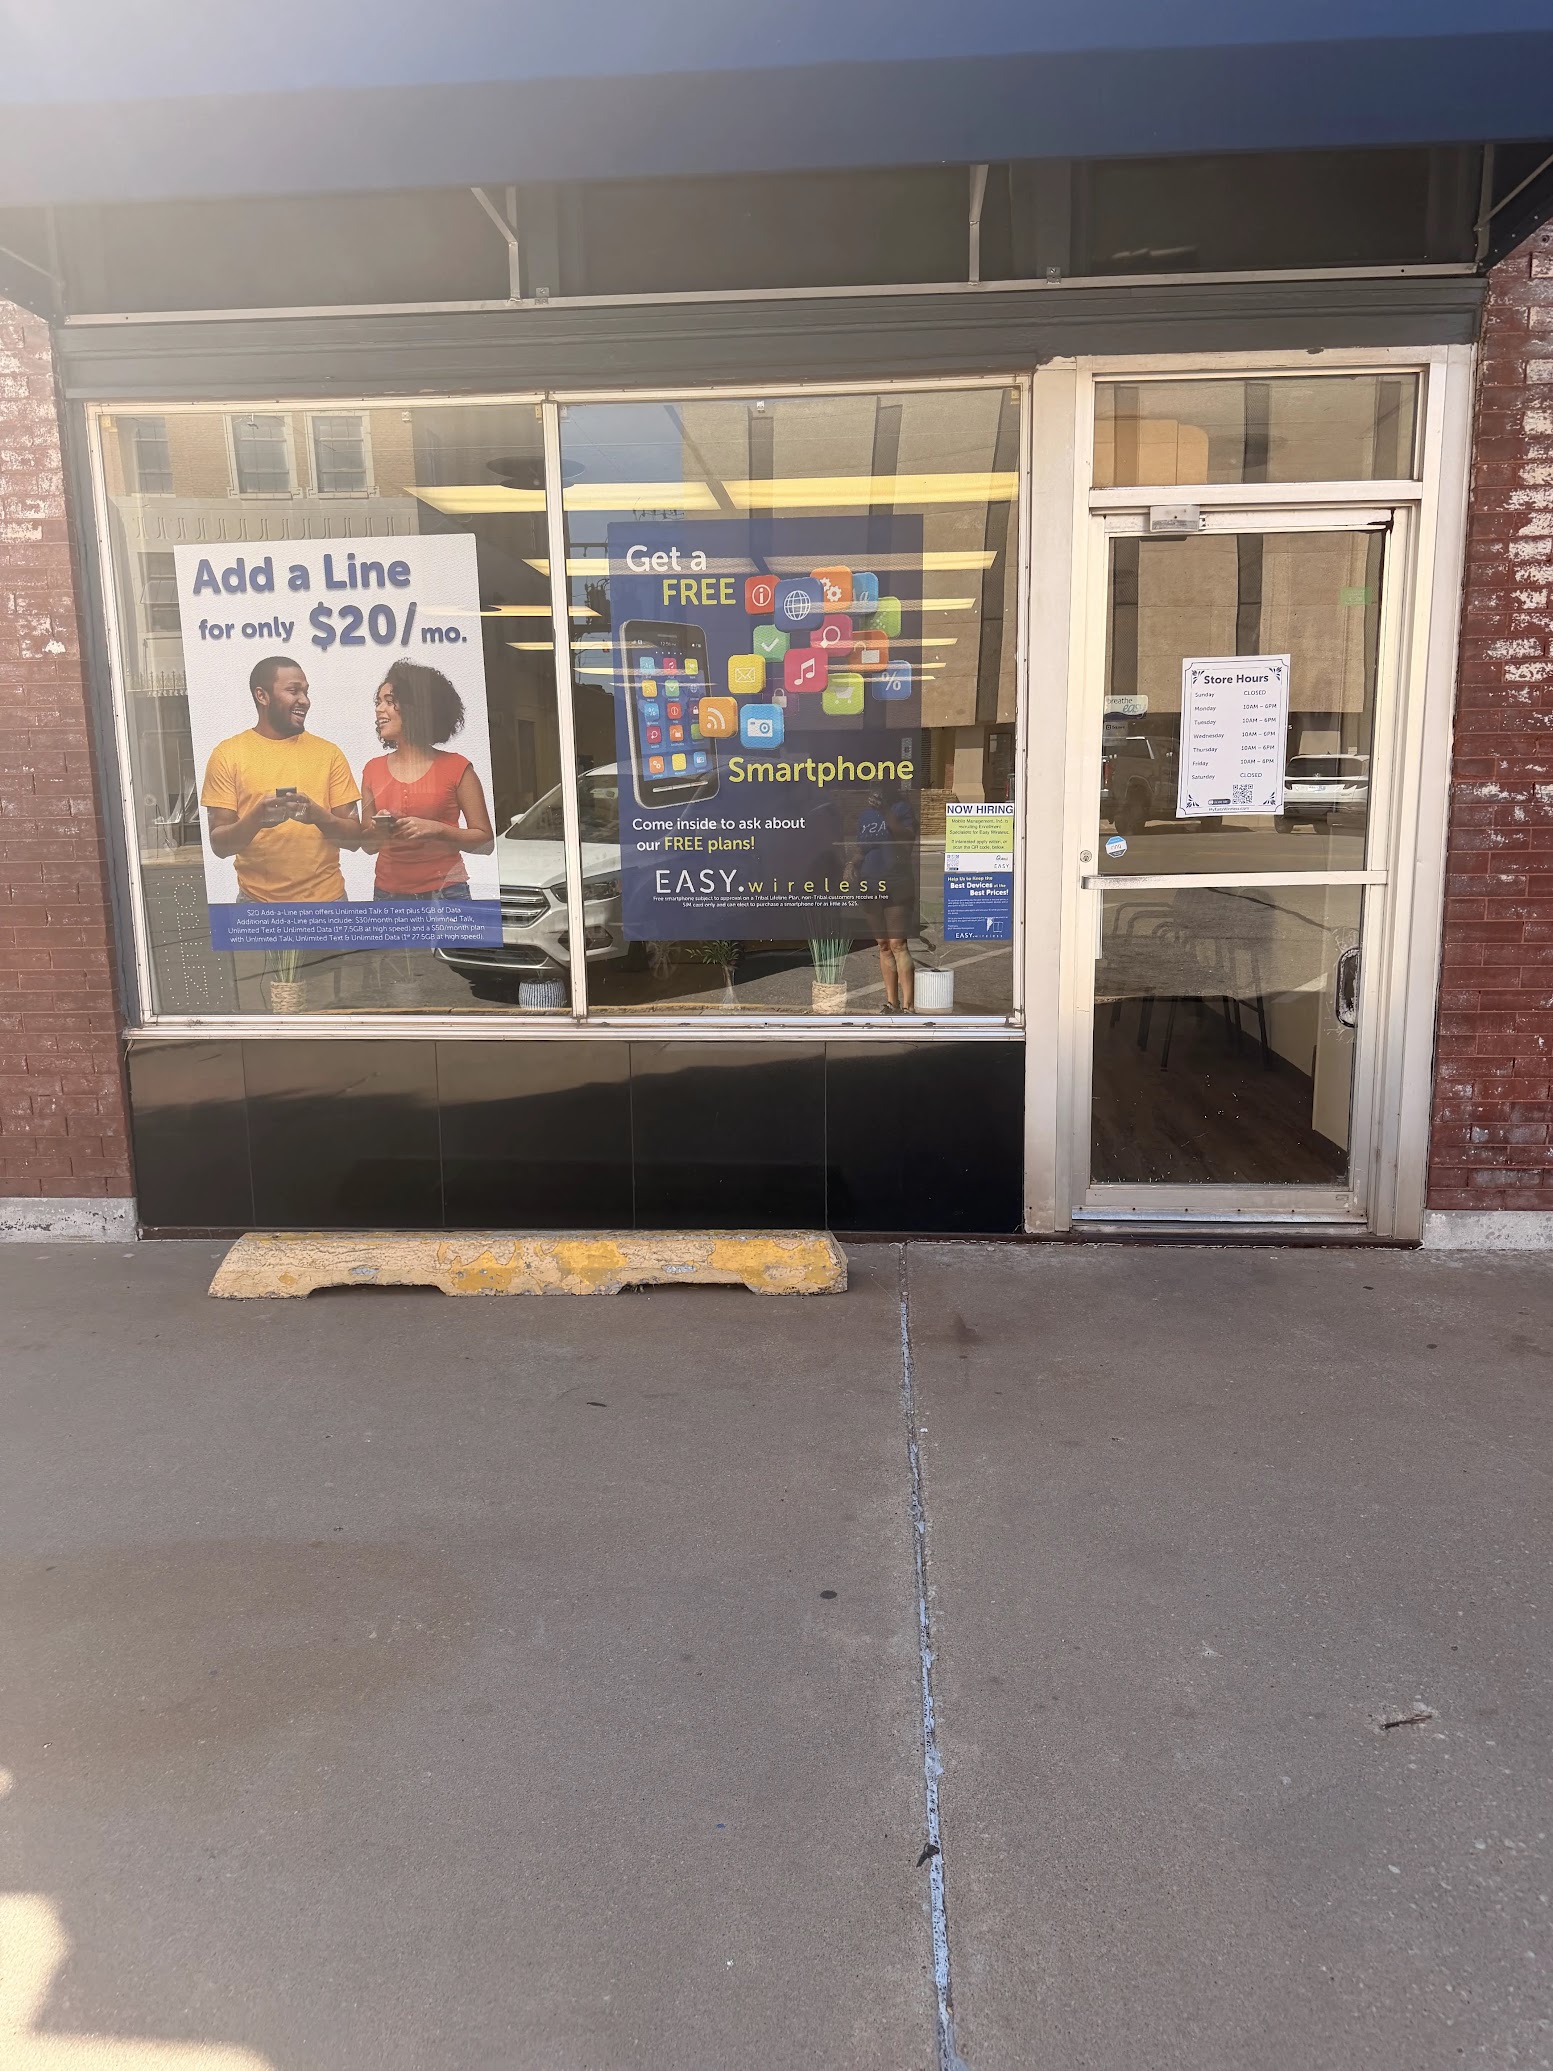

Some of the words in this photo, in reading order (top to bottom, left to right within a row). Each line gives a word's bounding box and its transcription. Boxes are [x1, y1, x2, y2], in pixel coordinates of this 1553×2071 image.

[626, 545, 681, 572] Get
[690, 551, 707, 570] a
[193, 556, 275, 595] Add
[288, 563, 310, 591] a
[323, 553, 411, 589] Line
[663, 578, 736, 606] FREE
[198, 619, 235, 640] for
[241, 616, 295, 642] only
[1204, 675, 1233, 684] Store
[1237, 674, 1269, 683] Hours
[728, 756, 914, 788] Smartphone
[947, 805, 973, 814] NOW
[977, 805, 1013, 814] HIRING
[632, 818, 673, 830] Come
[676, 817, 717, 830] inside
[720, 818, 735, 829] to
[738, 817, 761, 829] ask
[764, 817, 806, 829] about
[636, 840, 660, 851] our
[665, 836, 703, 850] FREE
[707, 836, 755, 853] plans!
[299, 909, 313, 917] plan
[406, 907, 420, 915] plus
[309, 917, 327, 925] plans
[394, 916, 409, 924] plan
[459, 915, 475, 923] Talk,
[343, 925, 364, 933] 7.5GB
[373, 925, 388, 933] high
[174, 882, 208, 998] OPEN
[444, 933, 460, 941] high
